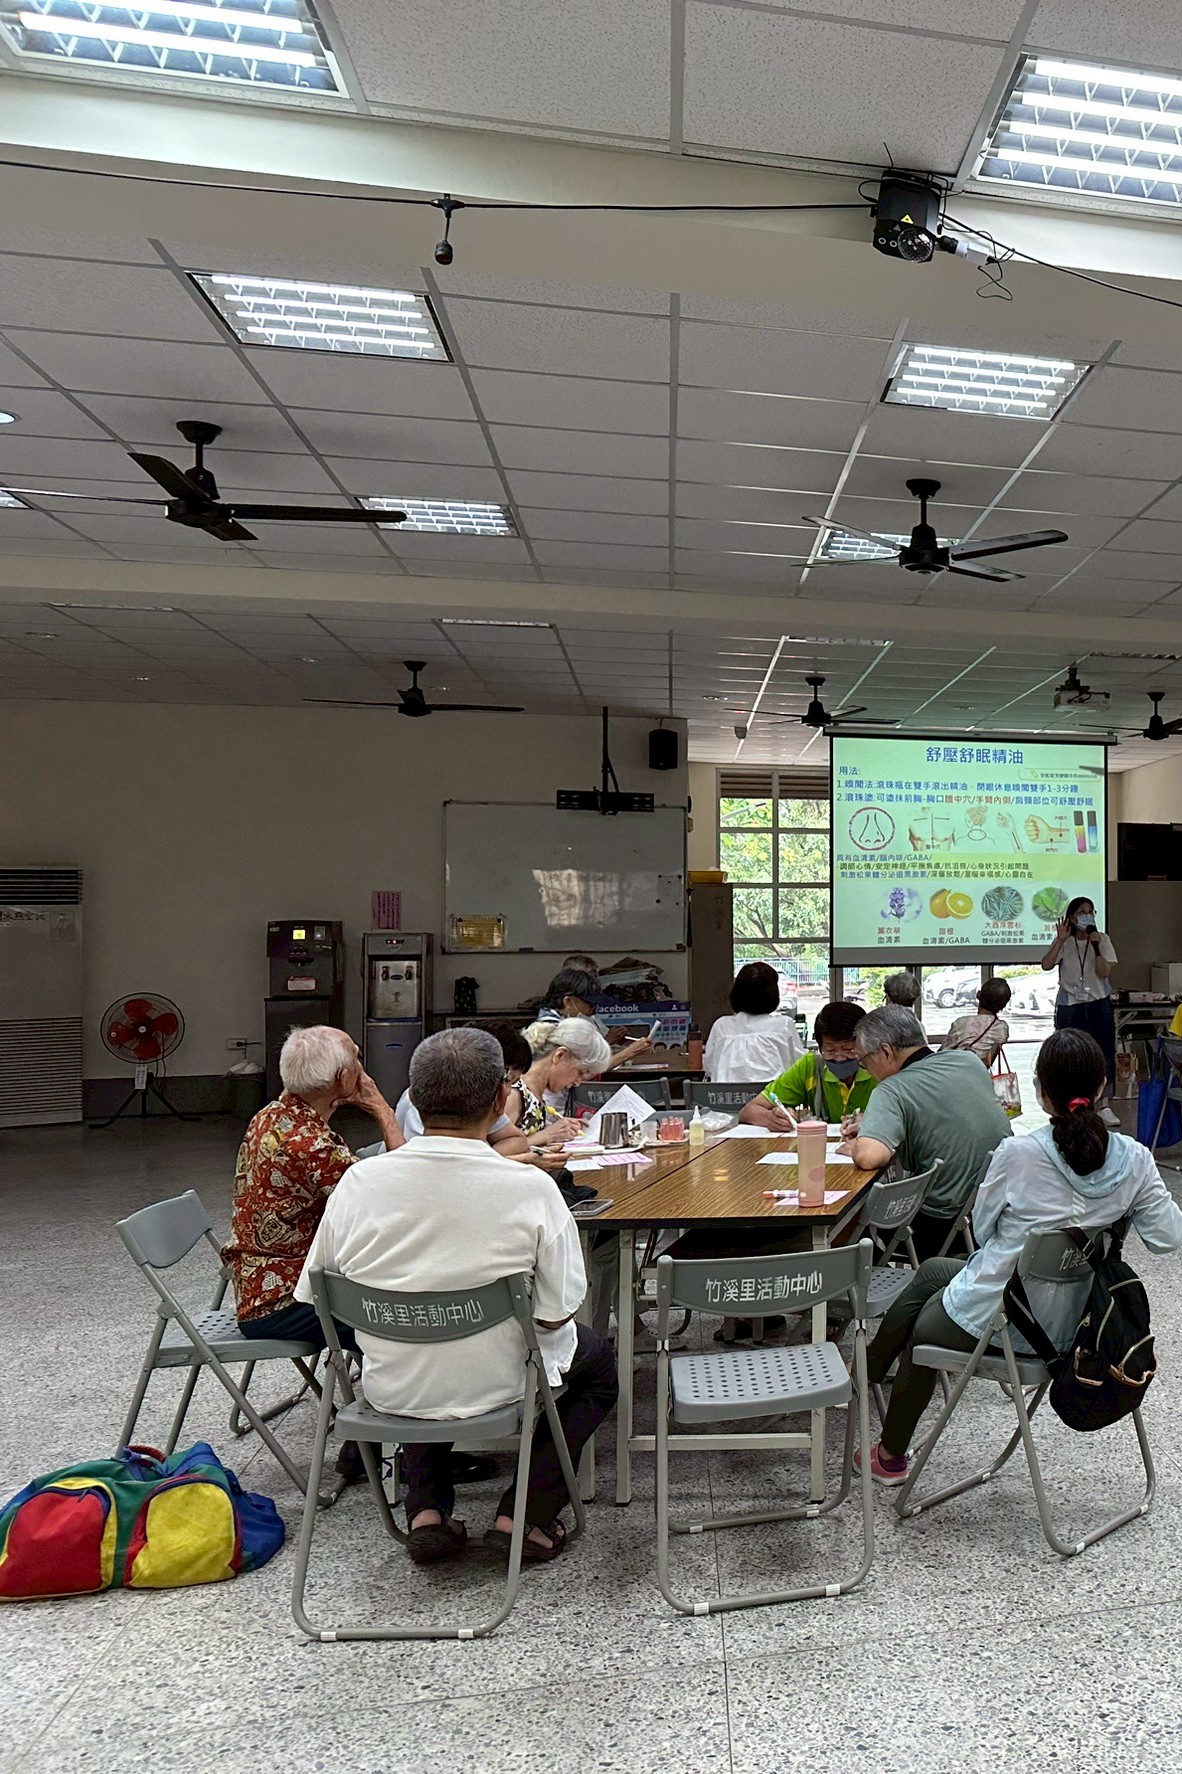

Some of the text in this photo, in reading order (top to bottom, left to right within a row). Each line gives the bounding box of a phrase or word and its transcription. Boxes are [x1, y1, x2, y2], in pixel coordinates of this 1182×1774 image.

[926, 747, 1023, 764] 舒壓舒眠精油
[839, 766, 861, 776] 用法:
[878, 936, 900, 944] 血清素
[705, 1270, 823, 1303] 竹溪里活動中心
[362, 1297, 485, 1327] 竹溪里活動中心
